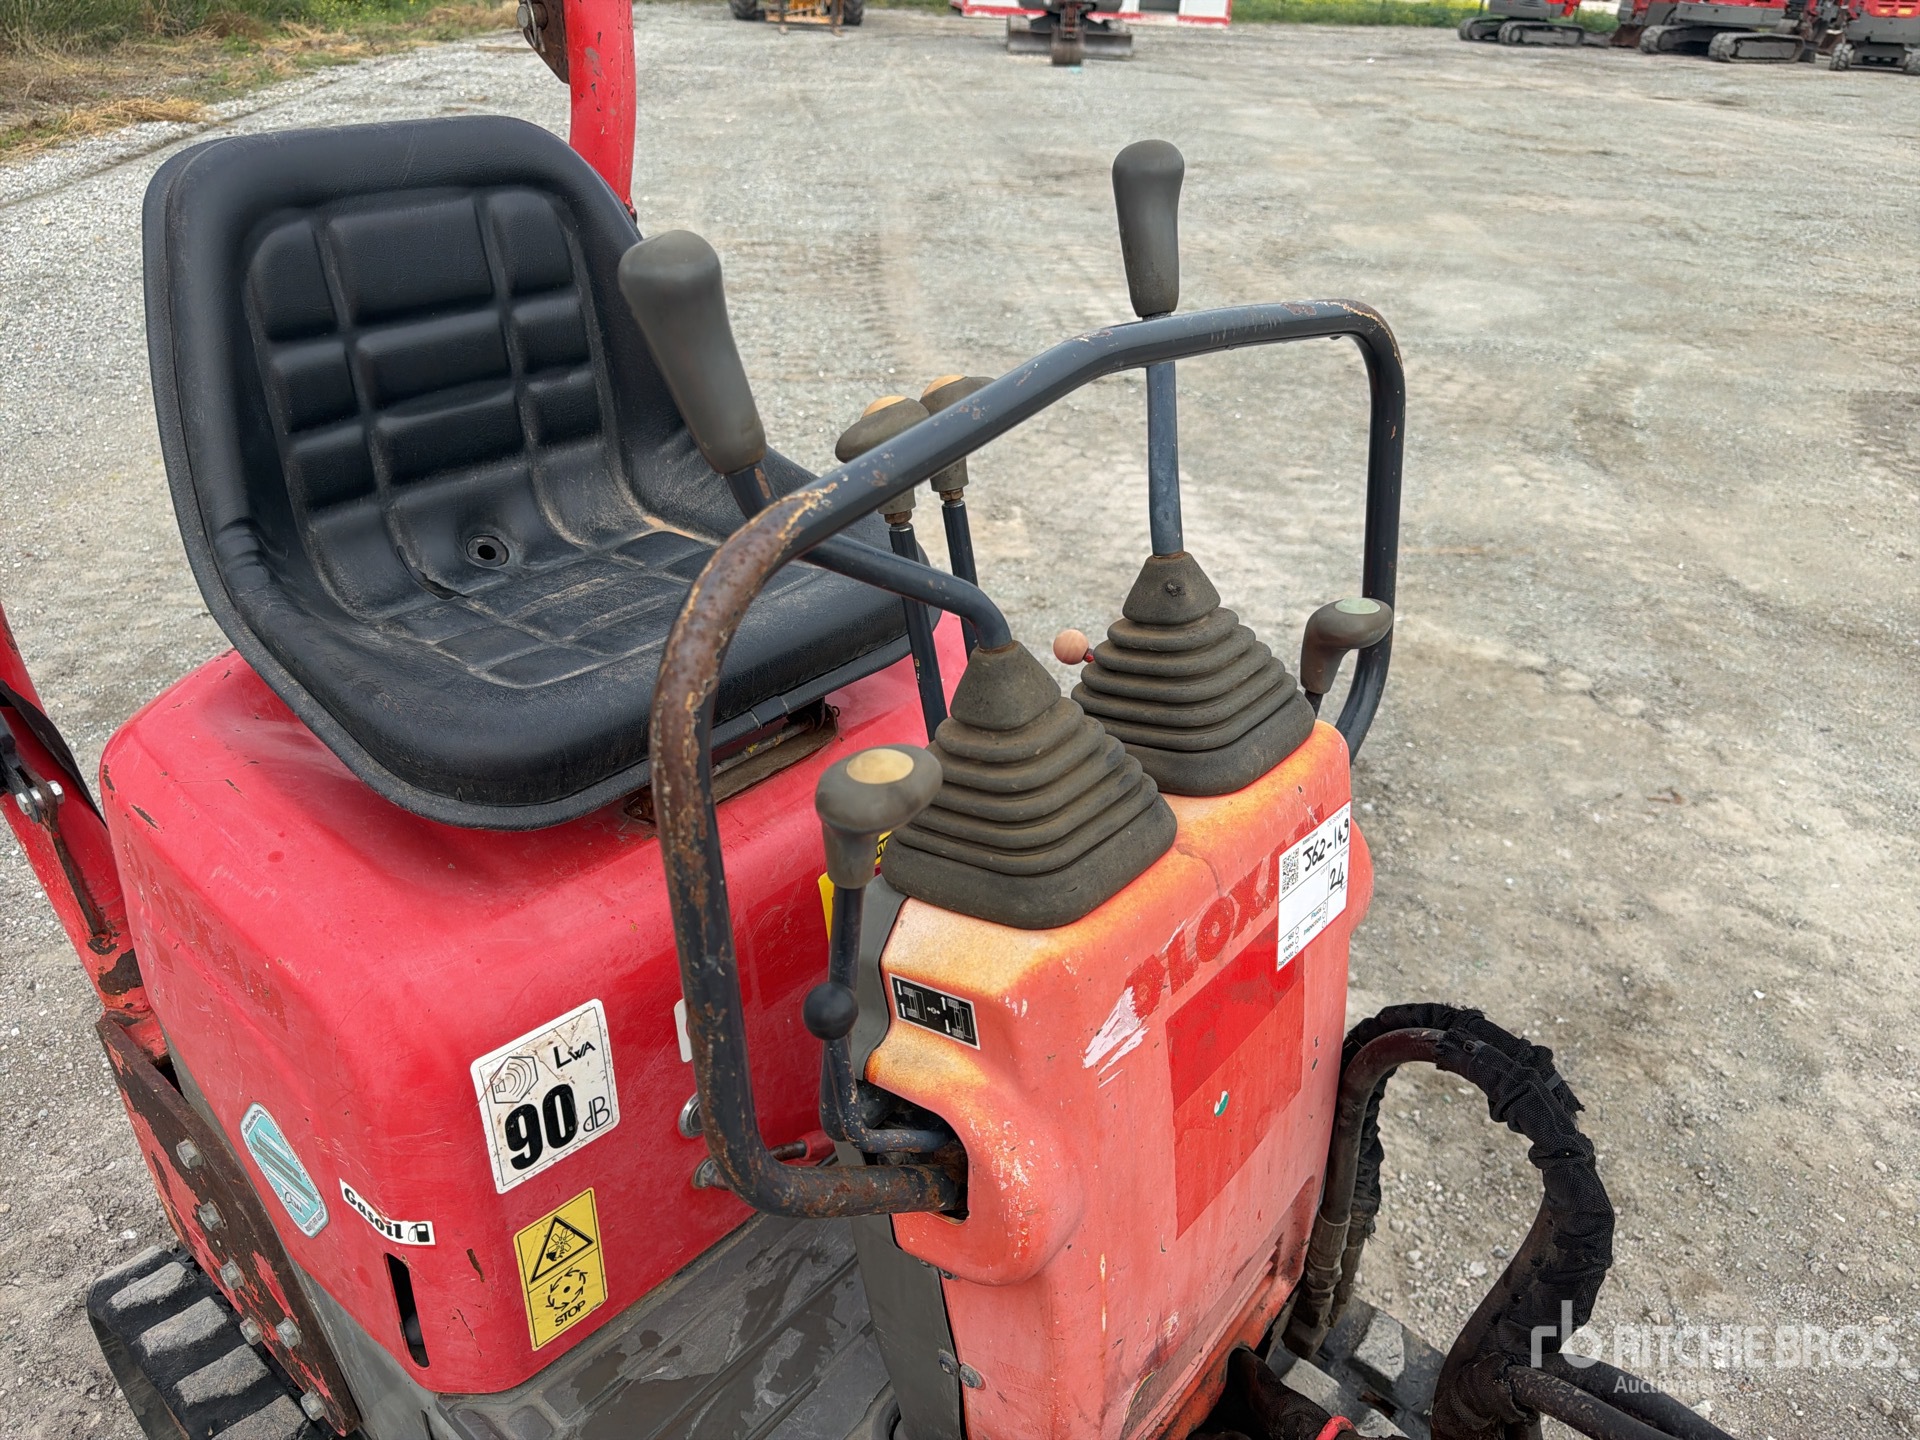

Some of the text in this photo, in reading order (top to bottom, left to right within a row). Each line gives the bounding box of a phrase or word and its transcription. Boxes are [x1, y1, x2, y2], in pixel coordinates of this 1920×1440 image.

[1329, 861, 1345, 890] 24
[504, 1083, 579, 1171] 90
[582, 1095, 611, 1133] dB
[344, 1187, 404, 1240] Gasoil
[554, 1299, 586, 1327] STOP
